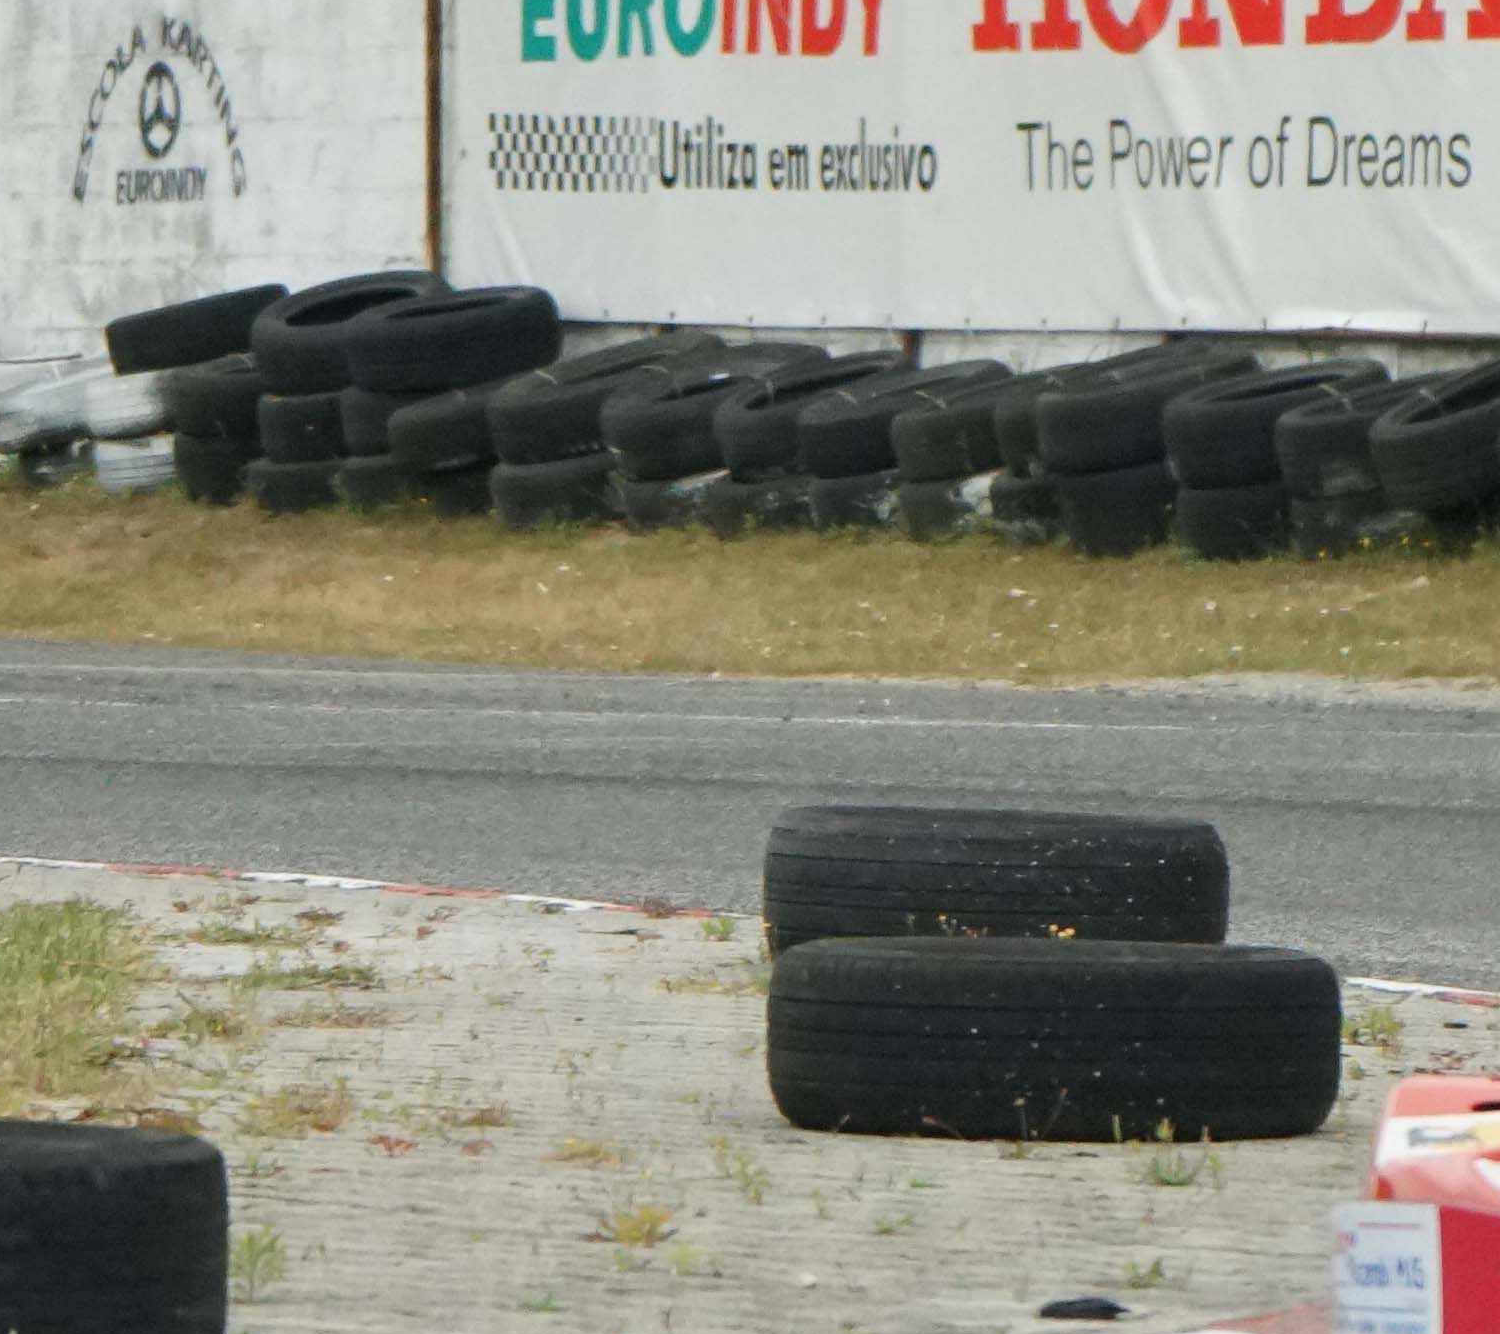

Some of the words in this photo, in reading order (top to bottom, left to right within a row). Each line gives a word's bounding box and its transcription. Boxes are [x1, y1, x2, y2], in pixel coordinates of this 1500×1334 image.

[656, 116, 758, 192] Utiliza
[768, 140, 811, 192] em
[820, 116, 937, 193] exclusivo
[1016, 120, 1096, 194] The
[1108, 119, 1234, 191] Power
[1247, 115, 1295, 188] of
[1306, 114, 1473, 189] Dreams
